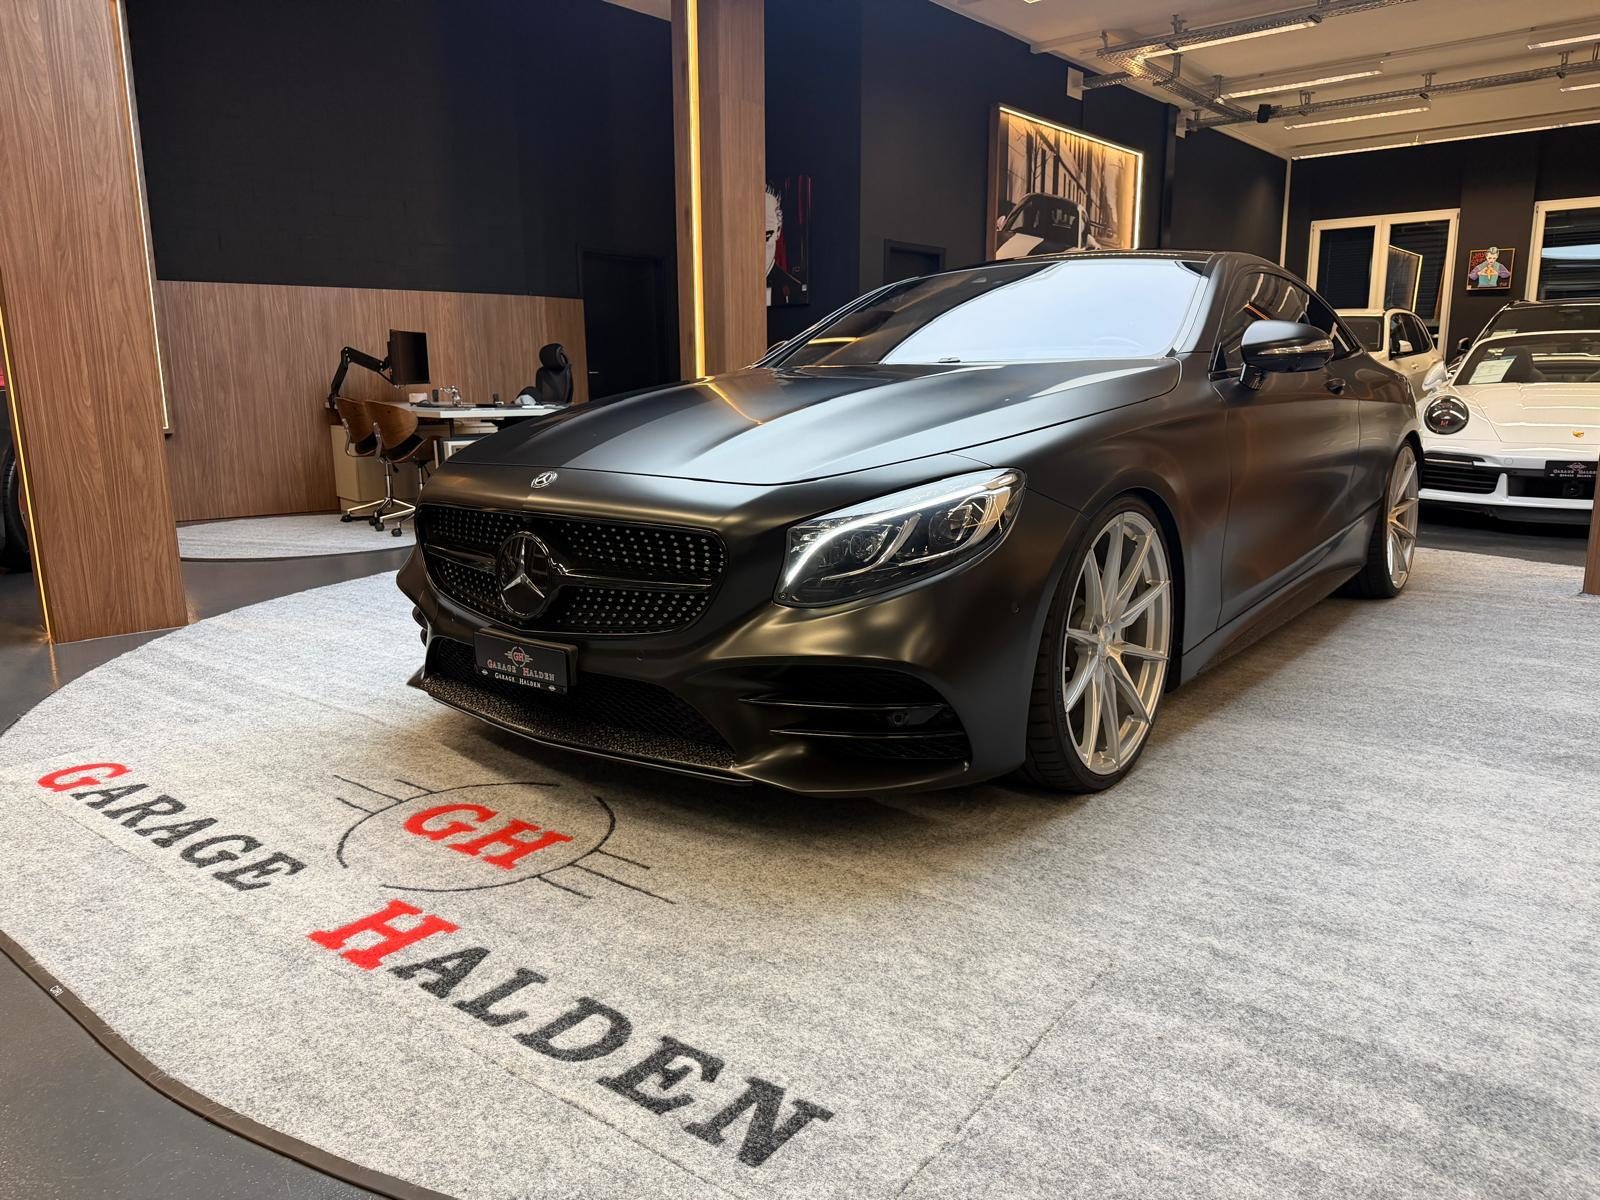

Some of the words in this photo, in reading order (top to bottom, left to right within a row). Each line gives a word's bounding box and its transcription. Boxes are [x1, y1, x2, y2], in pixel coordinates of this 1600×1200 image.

[513, 651, 524, 662] GH
[486, 659, 517, 673] GARAGE
[522, 667, 555, 682] HALDEN
[494, 672, 515, 682] GARAGE
[519, 678, 541, 688] HALDEN
[404, 803, 573, 870] GH
[37, 763, 306, 891] GARAGE
[309, 899, 834, 1167] HALDEN
